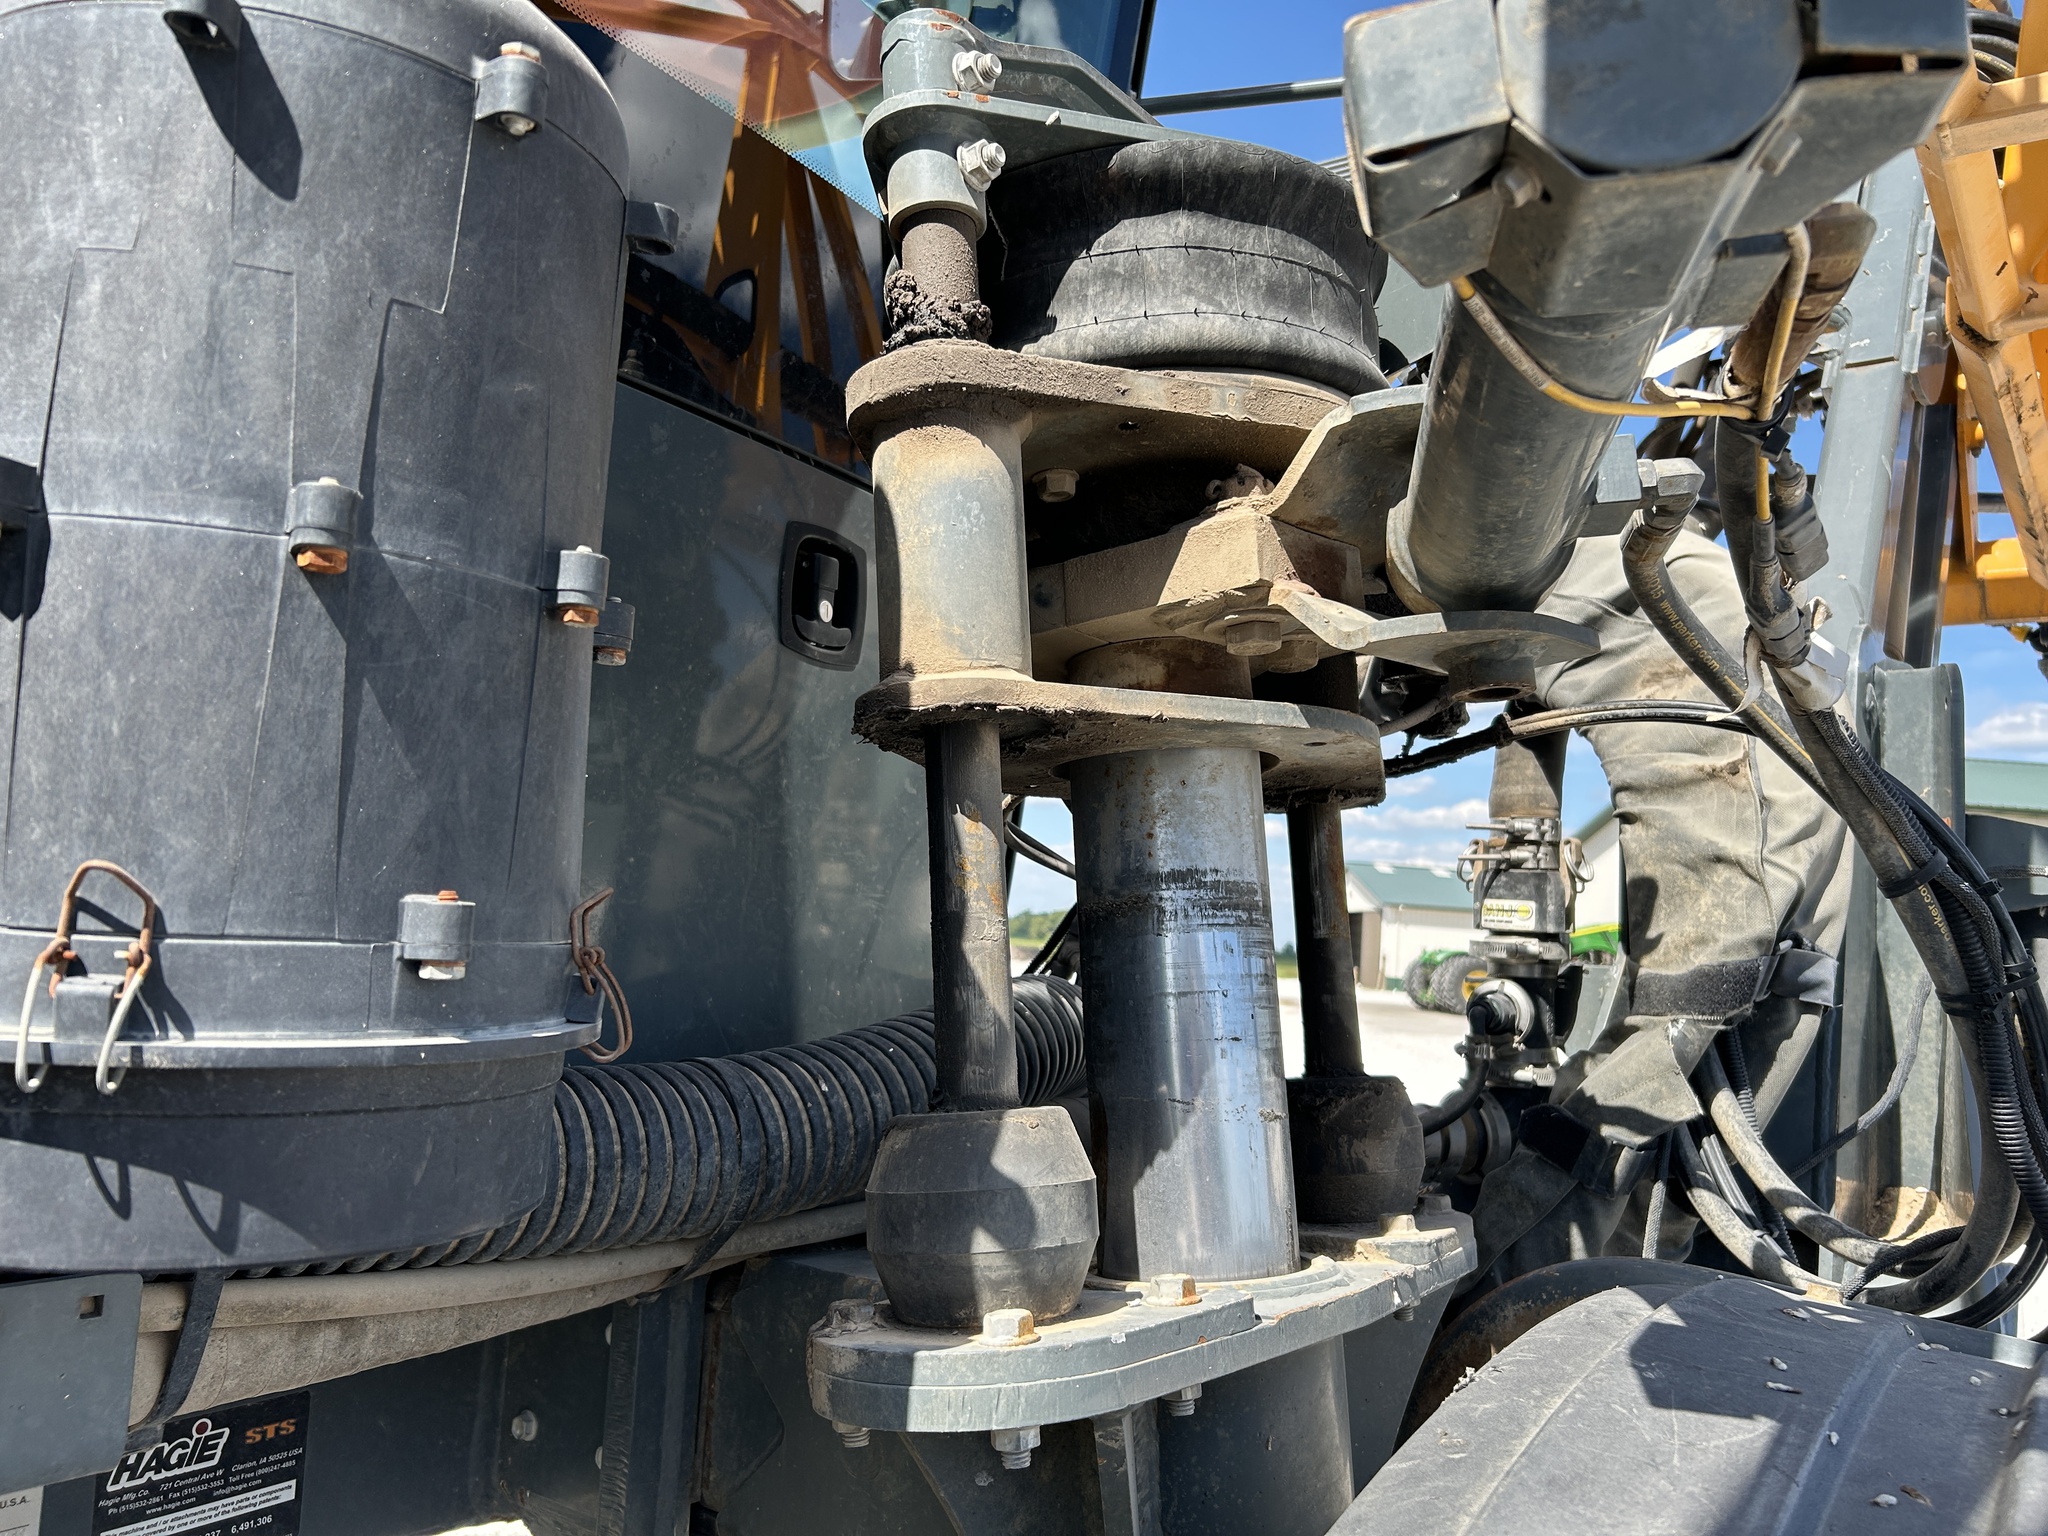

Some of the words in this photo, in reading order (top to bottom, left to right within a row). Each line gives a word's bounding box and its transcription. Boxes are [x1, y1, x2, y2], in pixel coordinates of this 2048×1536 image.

[1659, 599, 1720, 672] www.parker.com
[244, 1418, 297, 1445] STS
[98, 1496, 121, 1508] Hagie
[159, 1482, 173, 1491] 721
[174, 1474, 201, 1487] Central
[200, 1472, 215, 1481] Ave
[216, 1468, 225, 1476] W
[258, 1456, 267, 1465] IA
[288, 1447, 303, 1457] USA
[107, 1507, 118, 1515] Ph
[168, 1491, 181, 1499] Fax
[228, 1474, 240, 1483] Toll
[240, 1471, 255, 1480] Free
[145, 1497, 196, 1514] www.hagie.com
[213, 1479, 262, 1496] info@hagie.com
[170, 1508, 206, 1523] attachments
[207, 1505, 220, 1513] may
[220, 1499, 234, 1508] have
[235, 1495, 250, 1506] parts
[258, 1484, 292, 1498] components
[197, 1514, 212, 1522] more
[220, 1508, 231, 1516] the
[231, 1501, 260, 1513] following
[231, 1514, 273, 1534] 6,491,306
